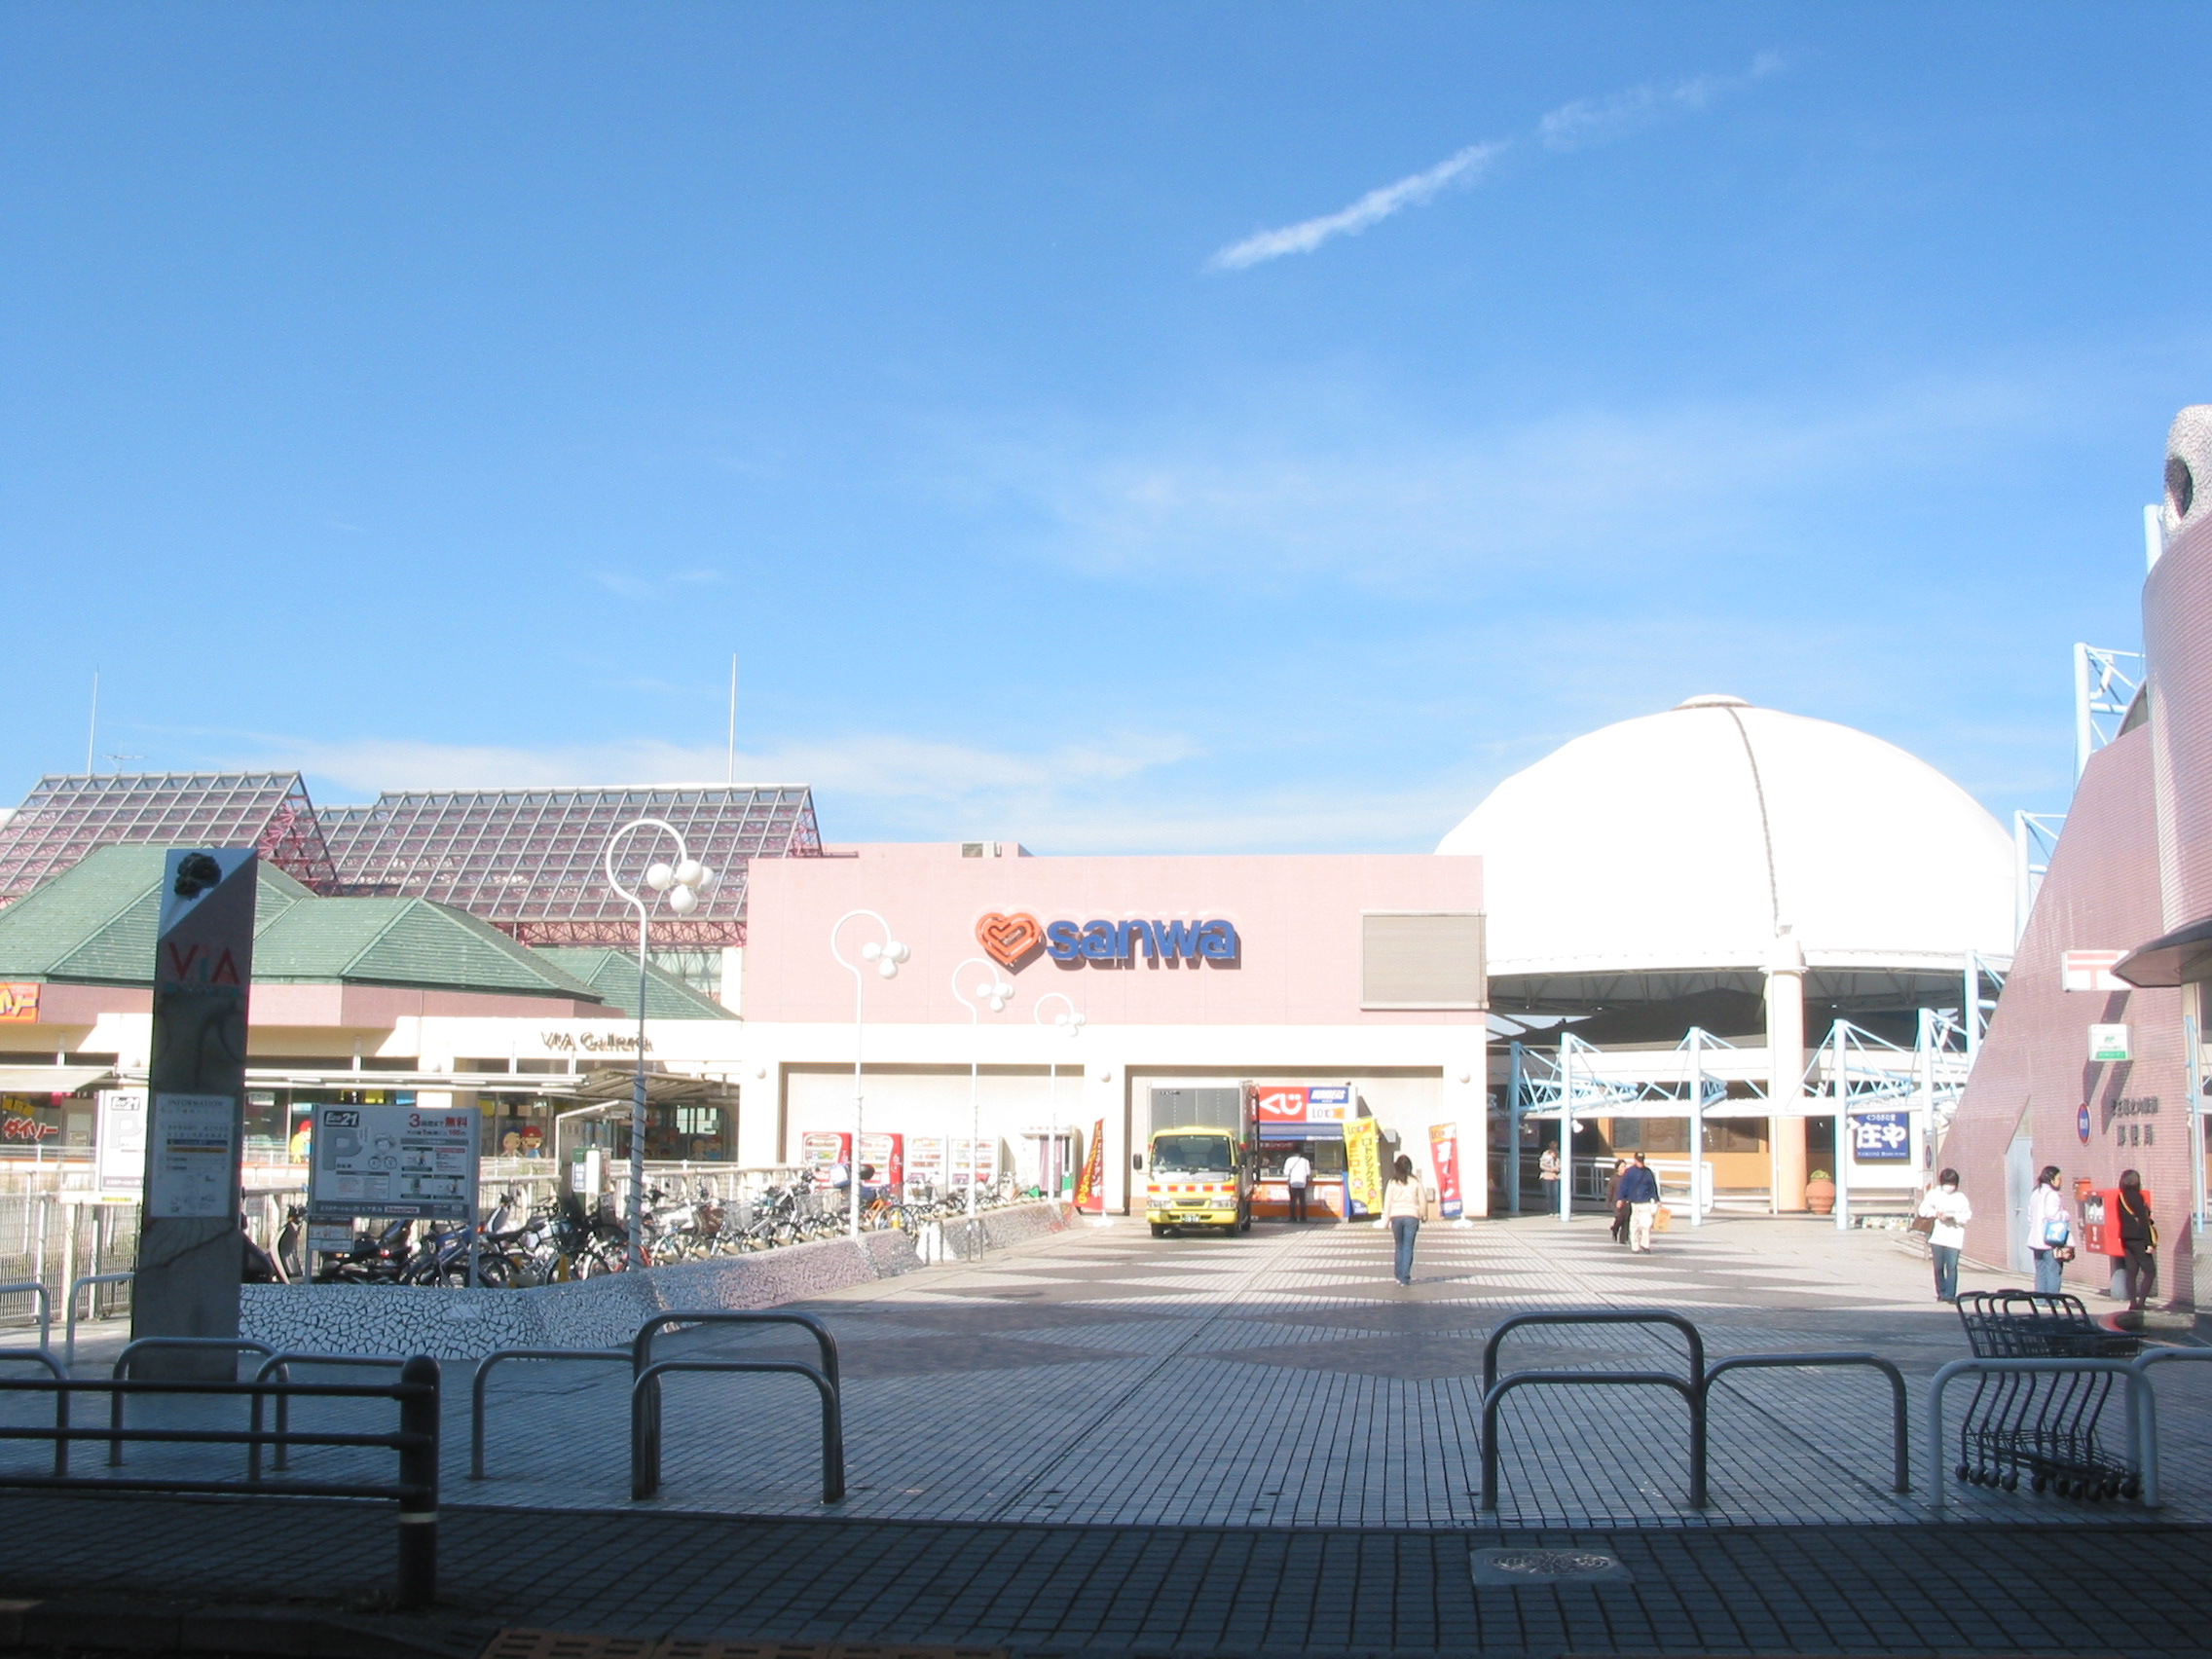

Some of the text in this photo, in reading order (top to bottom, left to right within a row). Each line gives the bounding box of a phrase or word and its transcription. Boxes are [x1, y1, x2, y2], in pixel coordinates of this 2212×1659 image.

[1046, 919, 1235, 960] sanwa
[1258, 1092, 1303, 1116] くじ
[3, 1118, 58, 1140] ダイソー
[1856, 1122, 1906, 1149] 庄や
